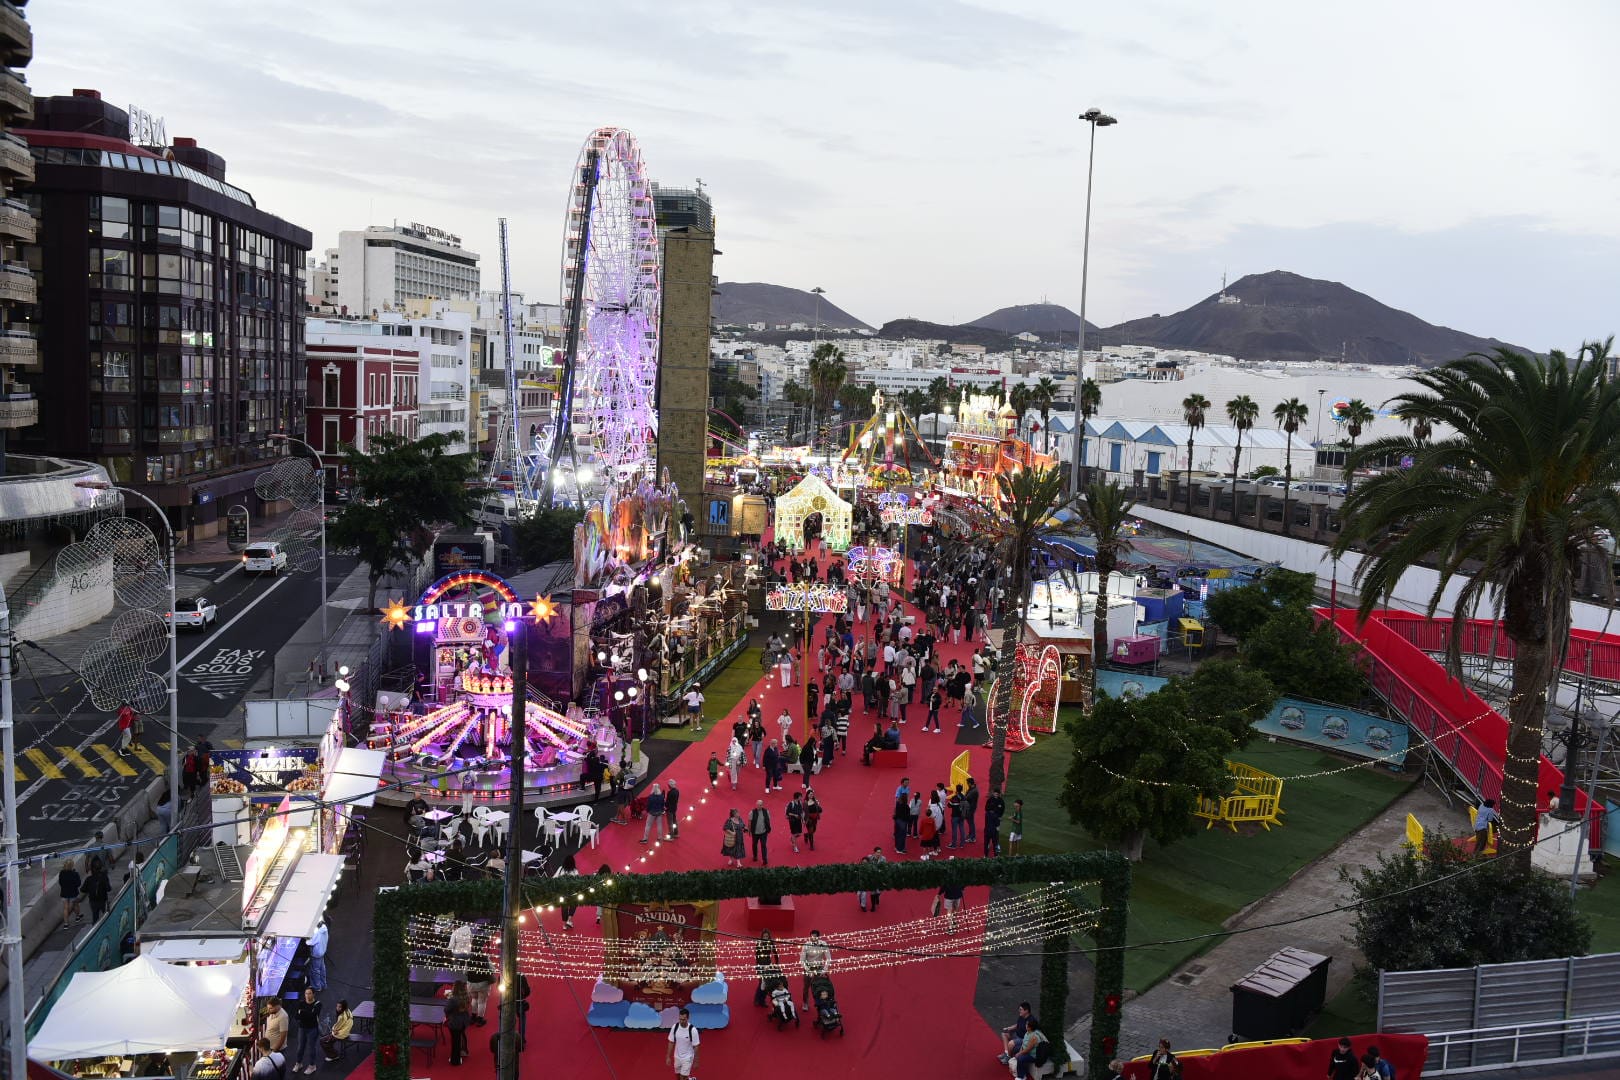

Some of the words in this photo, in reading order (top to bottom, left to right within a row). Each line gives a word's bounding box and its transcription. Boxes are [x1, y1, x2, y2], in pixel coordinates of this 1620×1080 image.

[129, 104, 168, 147] BBVA
[216, 648, 266, 658] TAXI
[210, 656, 253, 665] BUS
[193, 664, 252, 674] SOLO
[61, 785, 130, 802] BUS
[30, 803, 121, 821] SOLO
[635, 911, 687, 925] NAVIDAD
